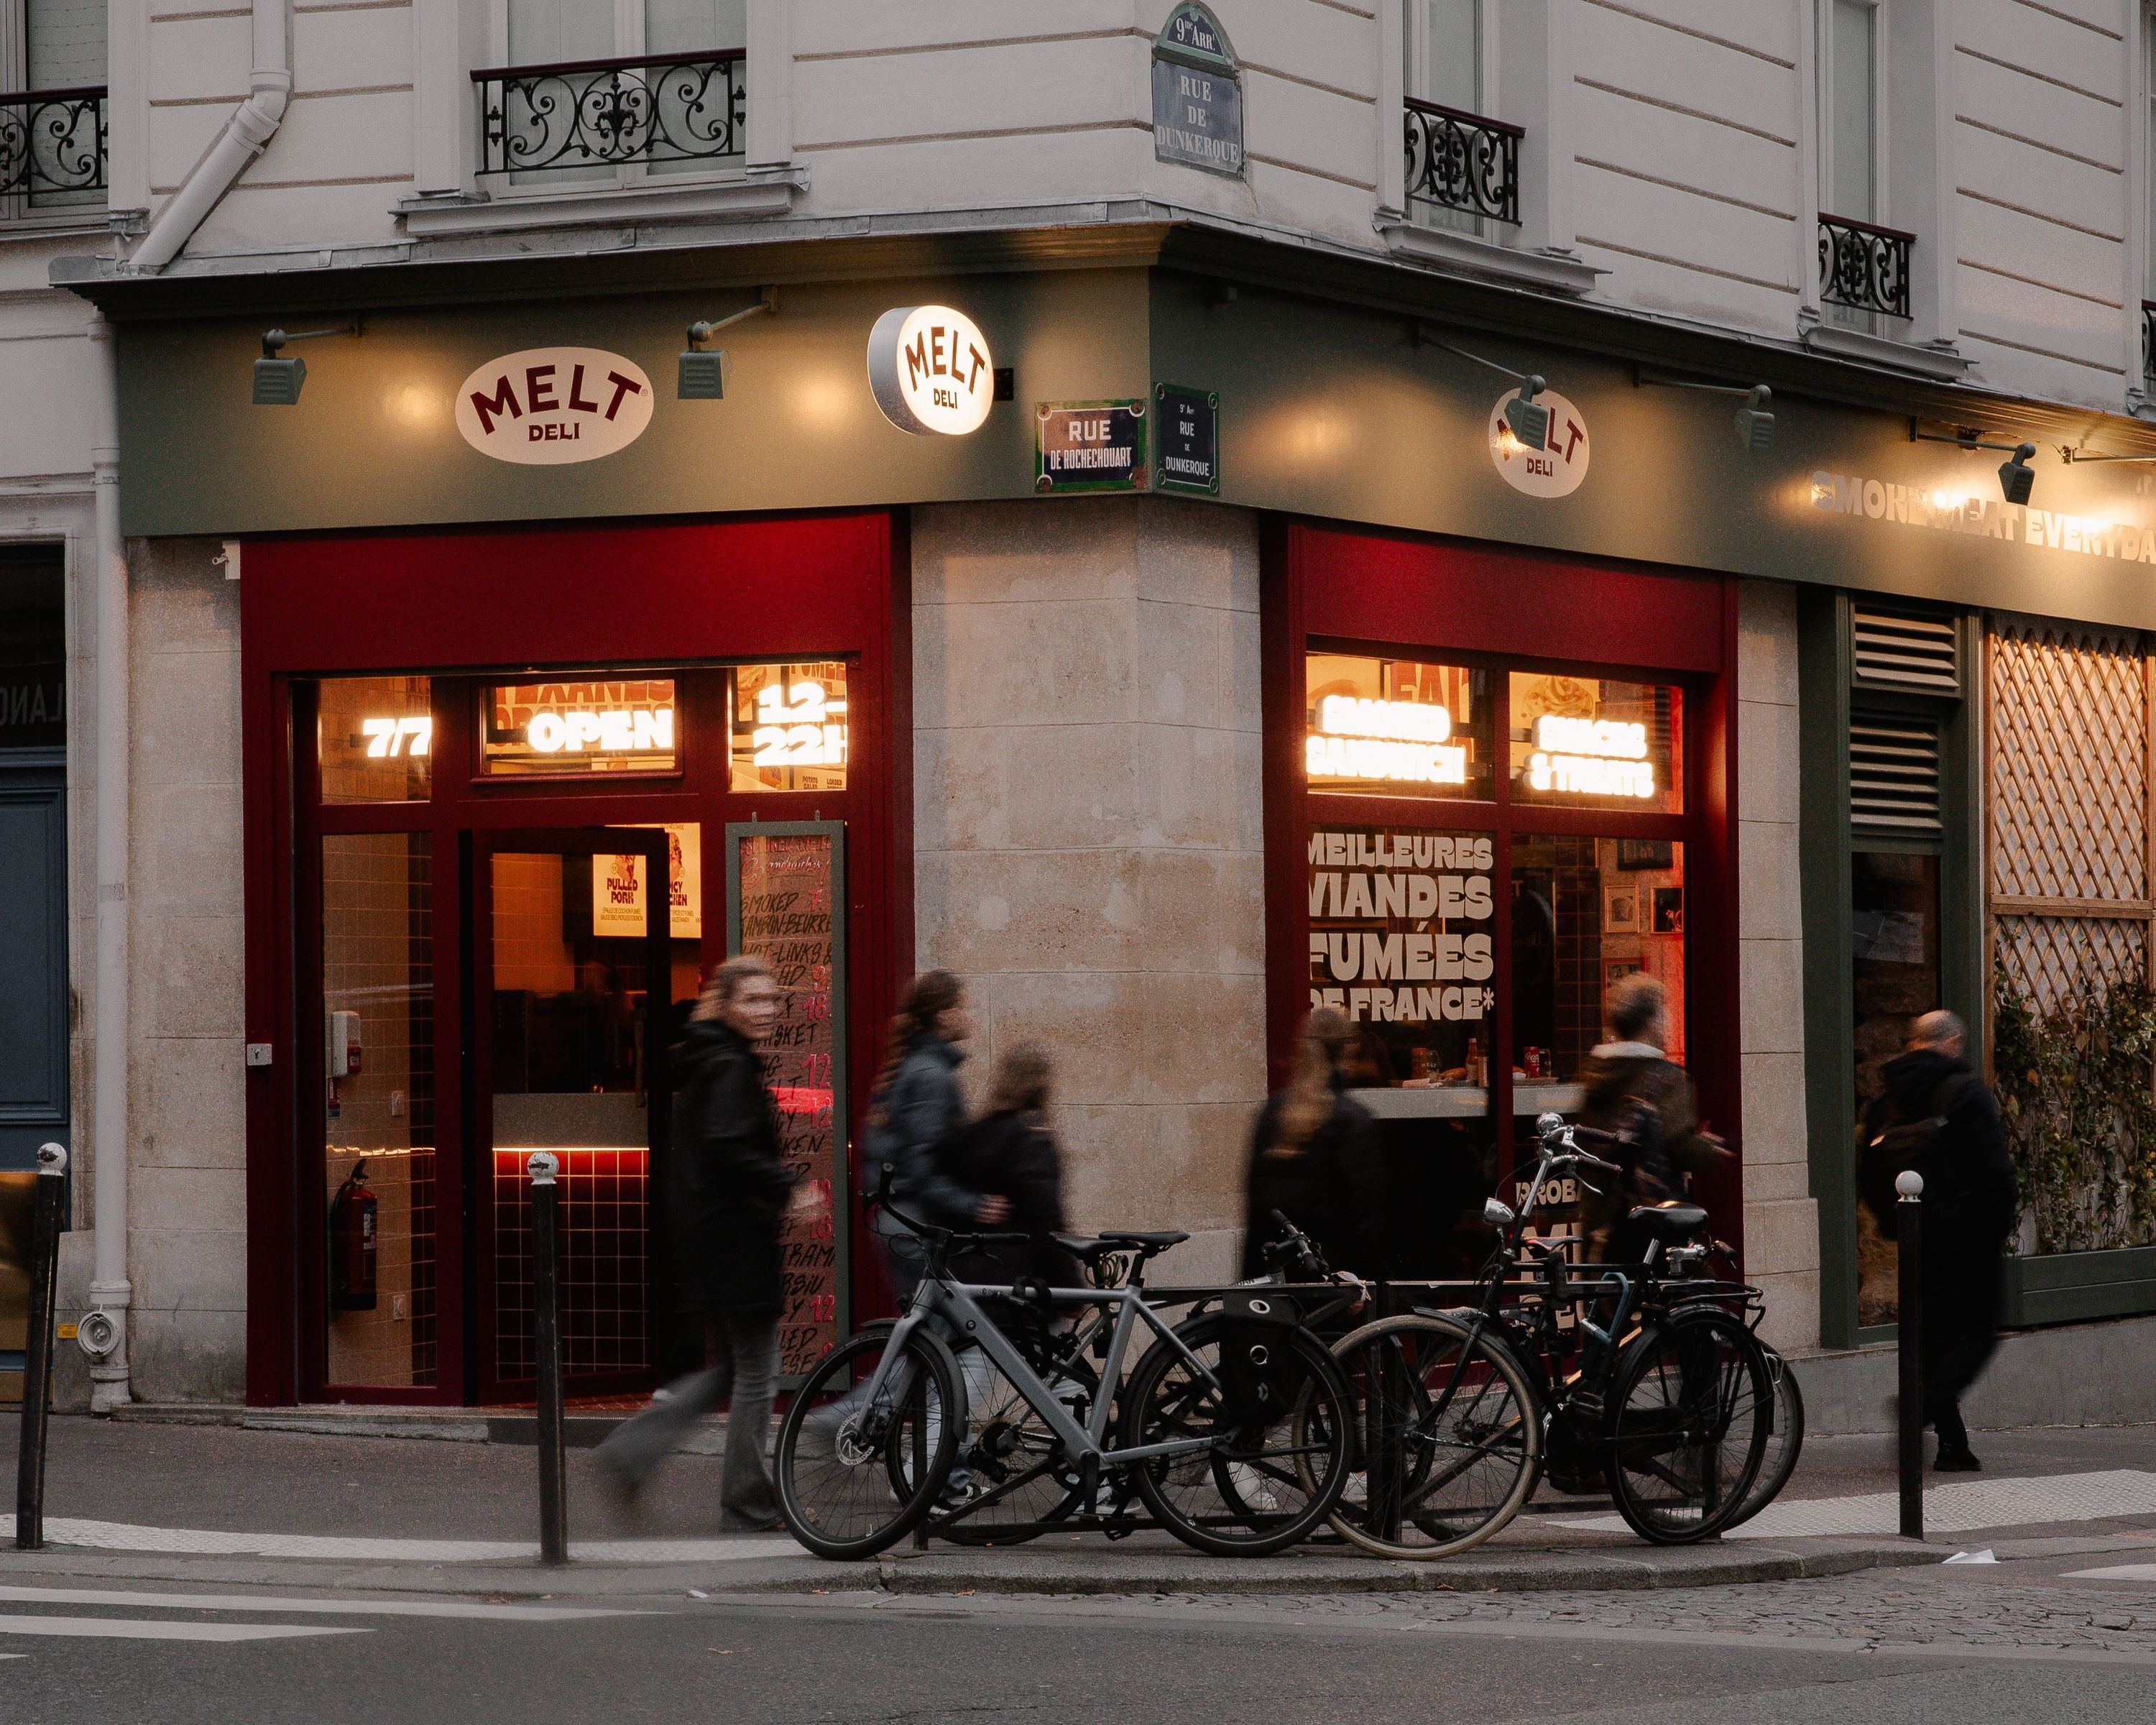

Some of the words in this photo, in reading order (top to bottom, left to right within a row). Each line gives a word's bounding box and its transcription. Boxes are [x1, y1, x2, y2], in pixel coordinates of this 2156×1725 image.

[1180, 75, 1212, 102] RUE
[1187, 105, 1206, 128] DE
[1156, 125, 1239, 162] DUNKERQUE
[905, 326, 985, 395] MELT
[469, 364, 642, 436] MELT
[933, 387, 958, 409] DELI
[528, 422, 580, 441] DELI
[1069, 419, 1111, 441] RUE
[1179, 420, 1194, 436] RUE
[1497, 403, 1584, 465] LT
[1050, 449, 1061, 470] DE
[1064, 446, 1132, 469] ROCHECHOUART
[1184, 443, 1190, 451] DE
[1165, 455, 1210, 477] DUNKERQUE
[1526, 456, 1553, 477] DELI
[363, 717, 432, 758] 7/7
[529, 709, 673, 753] OPEN
[1308, 832, 1493, 870] MEILLEURES
[607, 877, 638, 892] PULLED
[1309, 872, 1493, 920] VIANDES
[611, 891, 634, 904] PORK
[1309, 921, 1494, 982] FUMÉES
[762, 1076, 803, 1103] ELT
